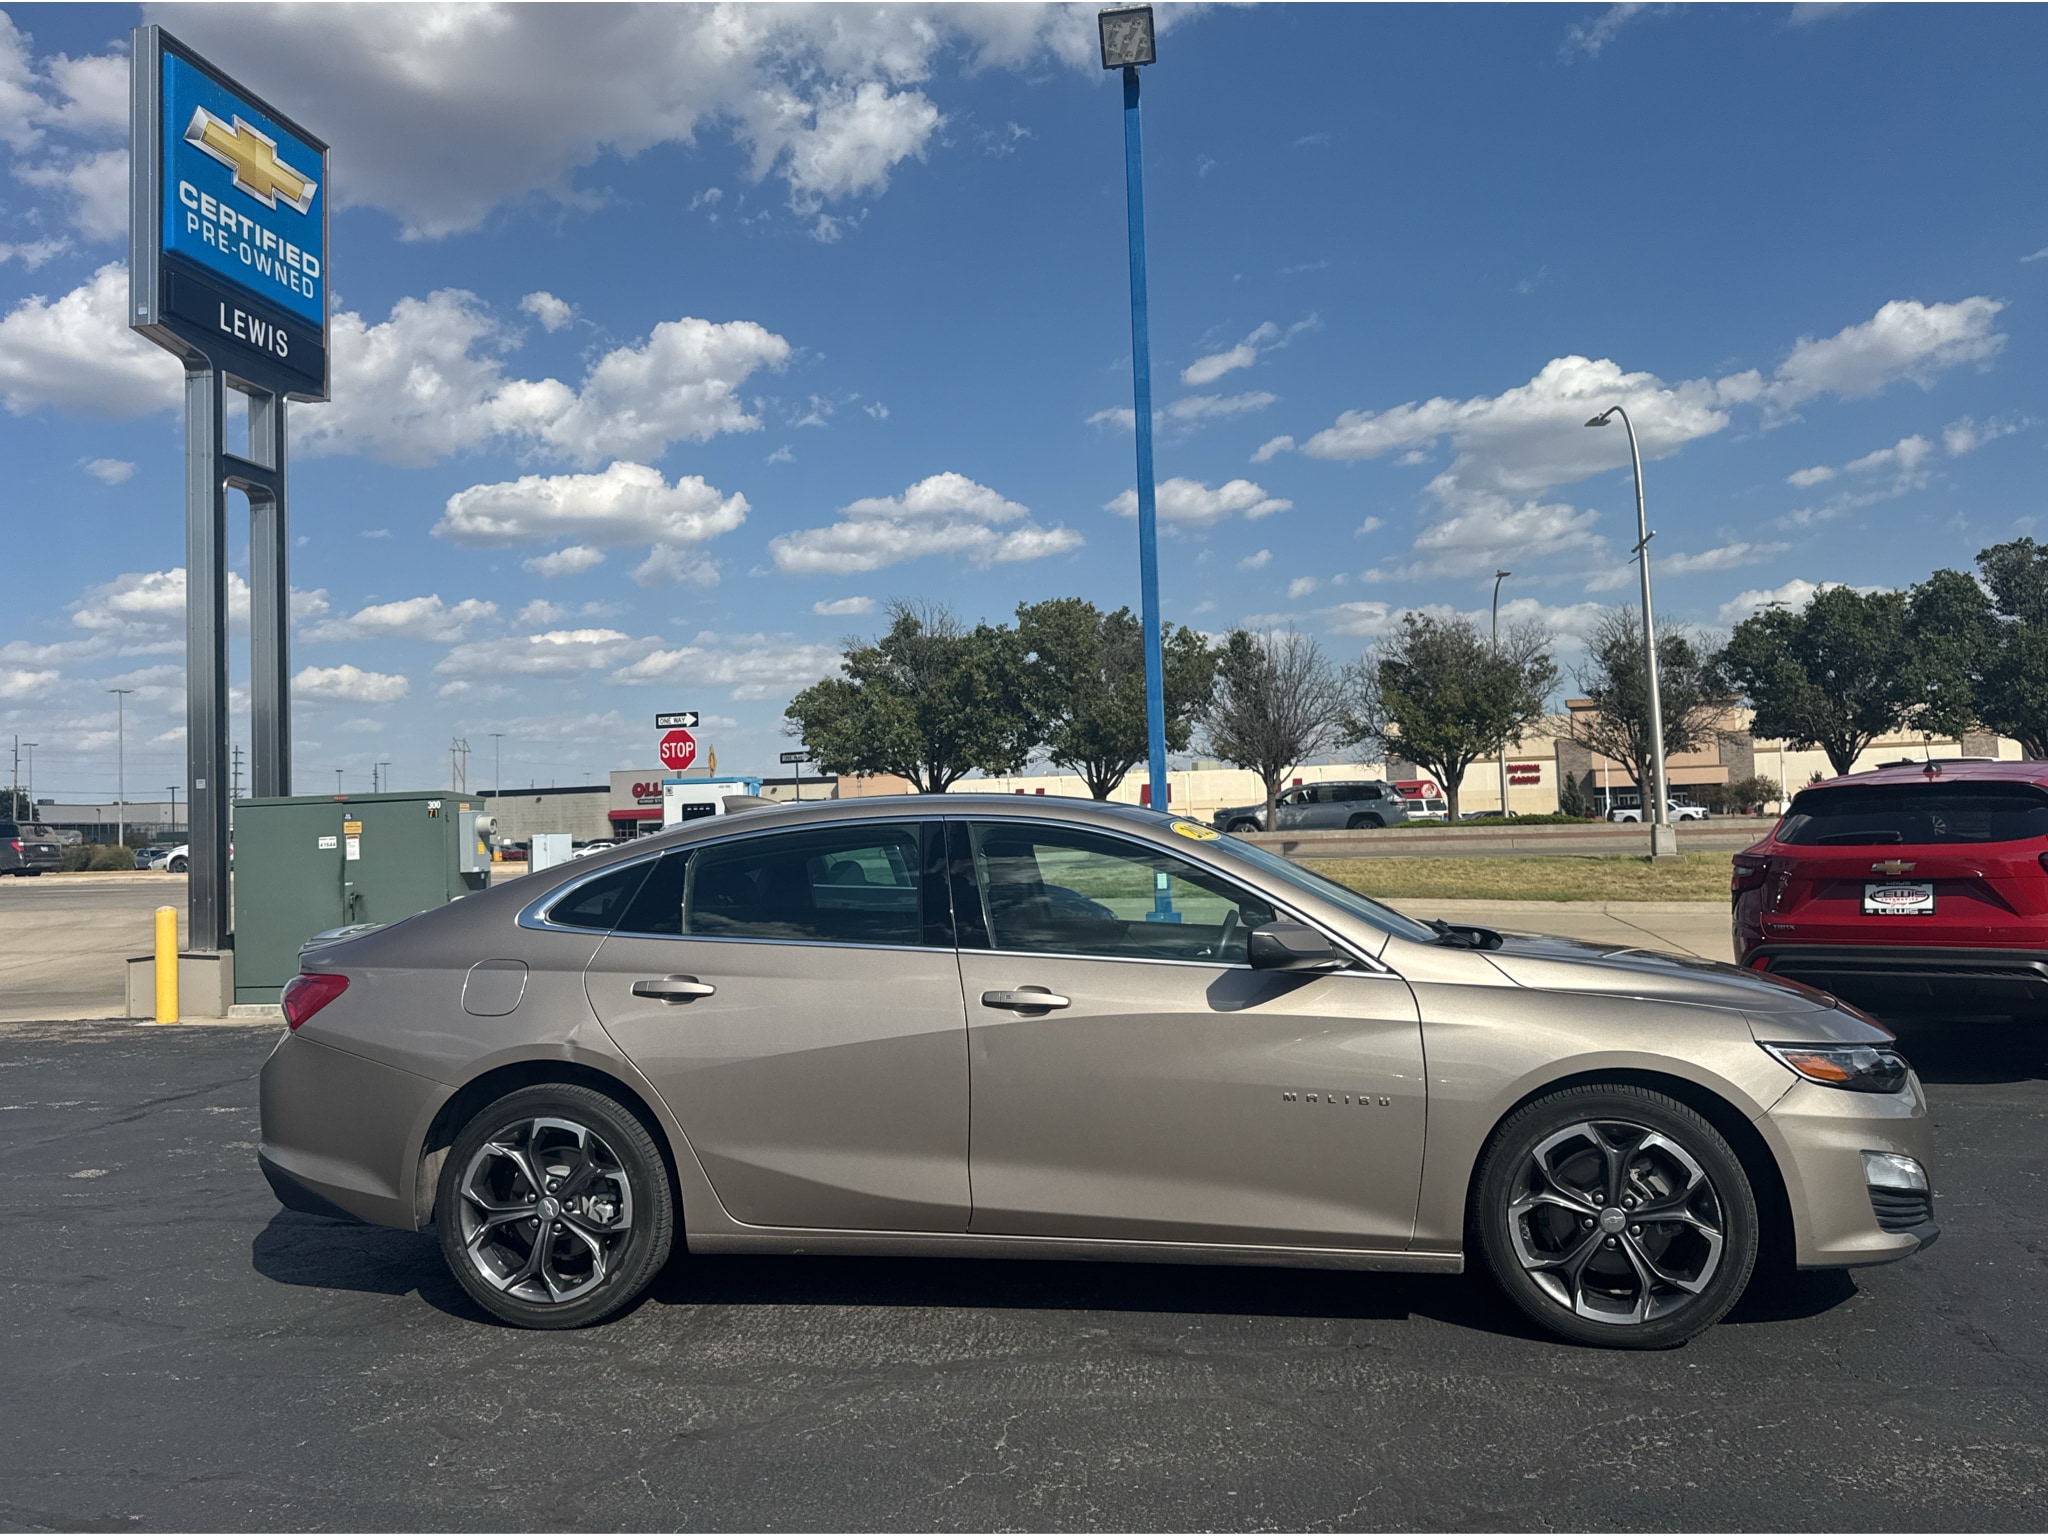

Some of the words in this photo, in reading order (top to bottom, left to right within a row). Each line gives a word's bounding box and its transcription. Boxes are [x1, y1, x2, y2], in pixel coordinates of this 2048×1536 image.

[179, 180, 320, 279] CERTIFIED
[187, 211, 314, 299] PRE-OWNED
[220, 302, 288, 358] LEWIS
[662, 741, 694, 758] STOP
[427, 800, 441, 809] 300
[1873, 890, 1927, 898] LEWIS
[1283, 1092, 1391, 1107] MALIBU
